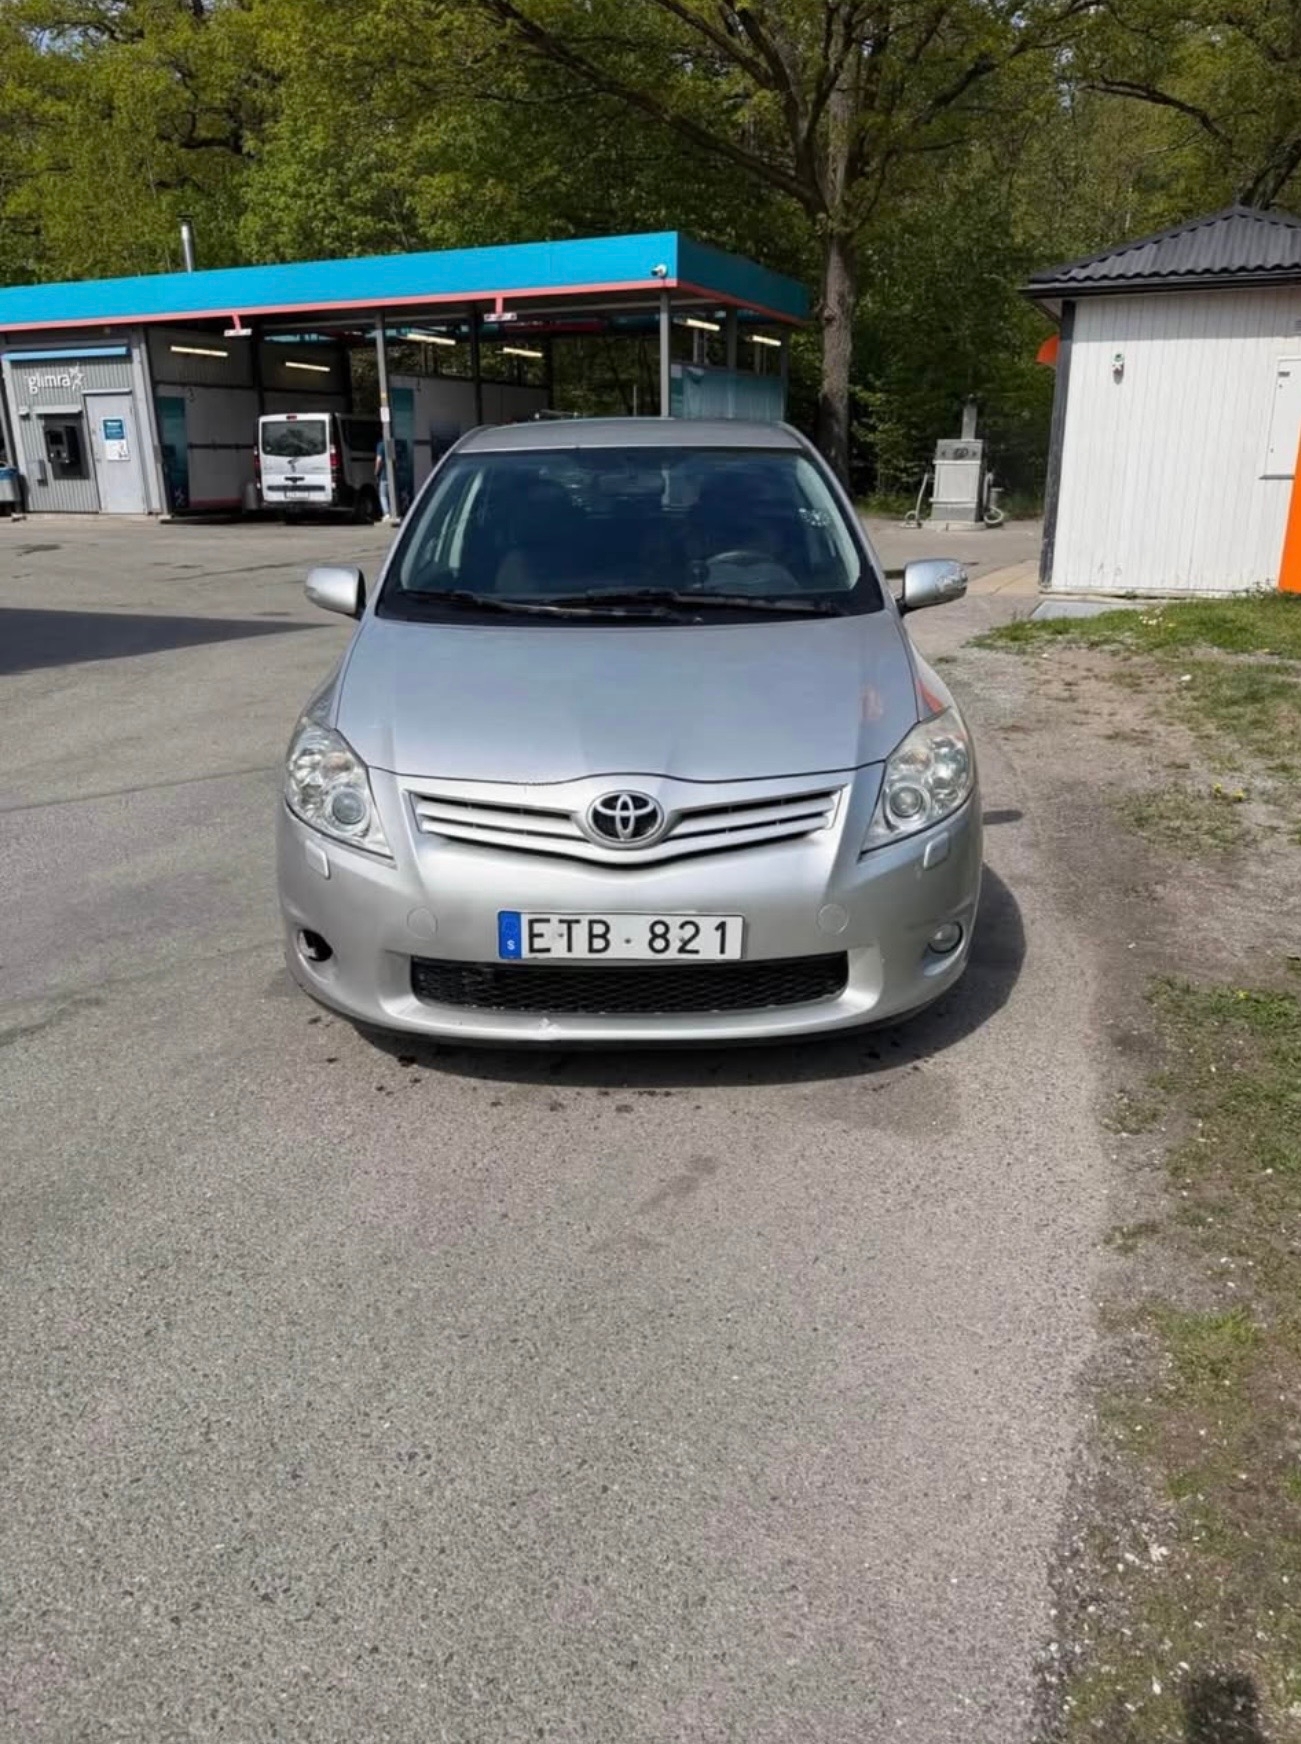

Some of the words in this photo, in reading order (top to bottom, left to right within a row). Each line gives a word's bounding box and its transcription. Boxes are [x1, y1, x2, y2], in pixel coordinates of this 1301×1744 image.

[28, 372, 71, 395] glimra
[506, 939, 515, 950] S
[528, 918, 611, 954] ETB
[648, 919, 727, 955] 821
